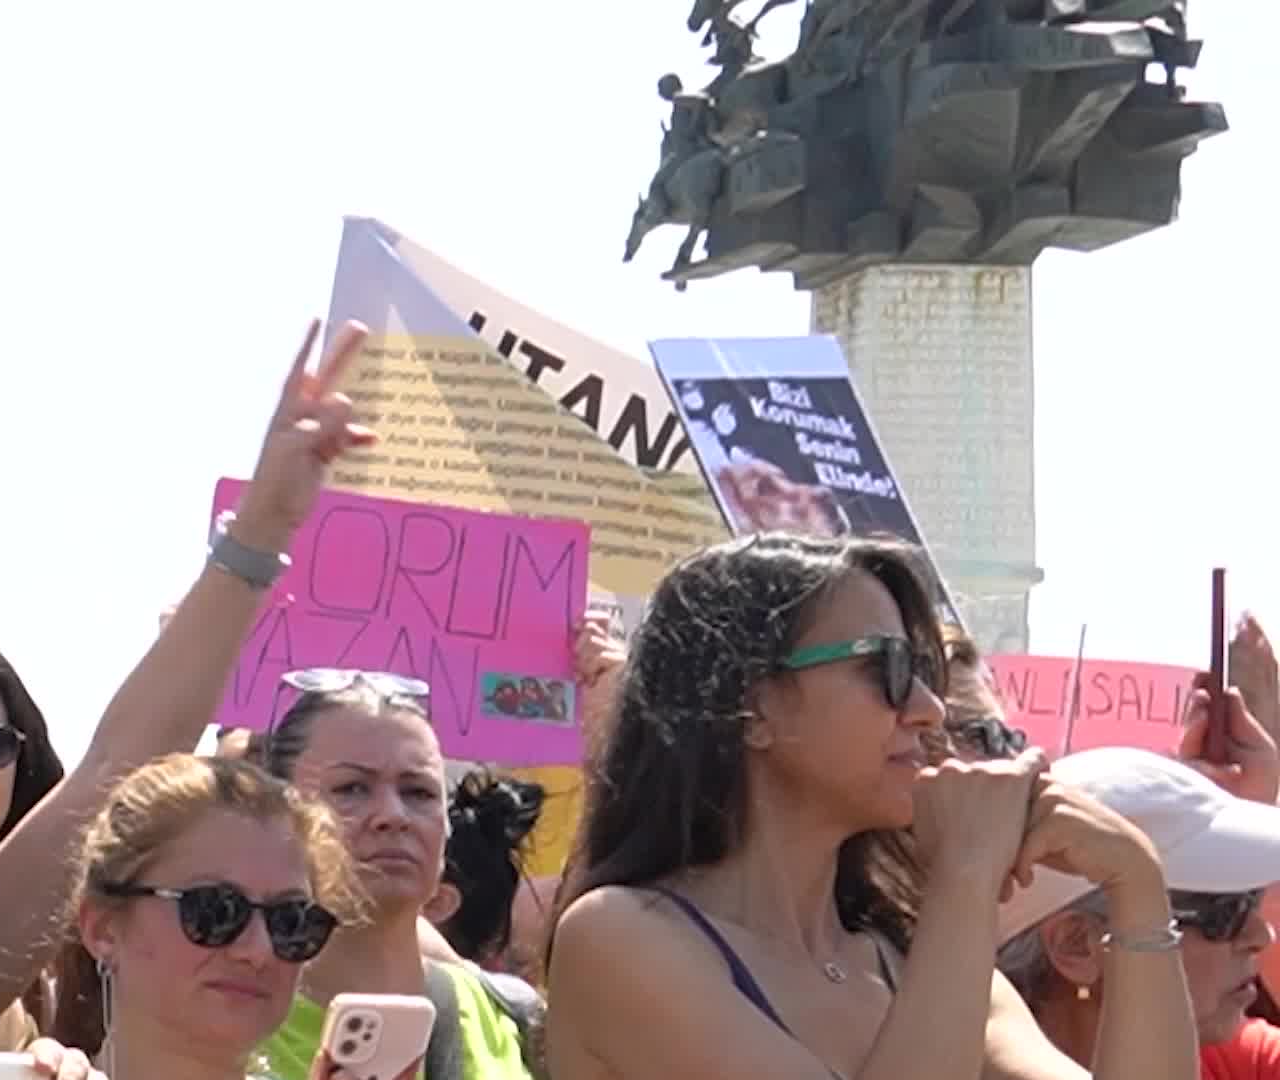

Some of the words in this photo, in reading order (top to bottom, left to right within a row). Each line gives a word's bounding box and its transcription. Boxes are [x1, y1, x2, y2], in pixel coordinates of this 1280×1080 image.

[749, 396, 857, 441] Korumak
[795, 431, 862, 465] Senin
[308, 504, 578, 640] ORUM
